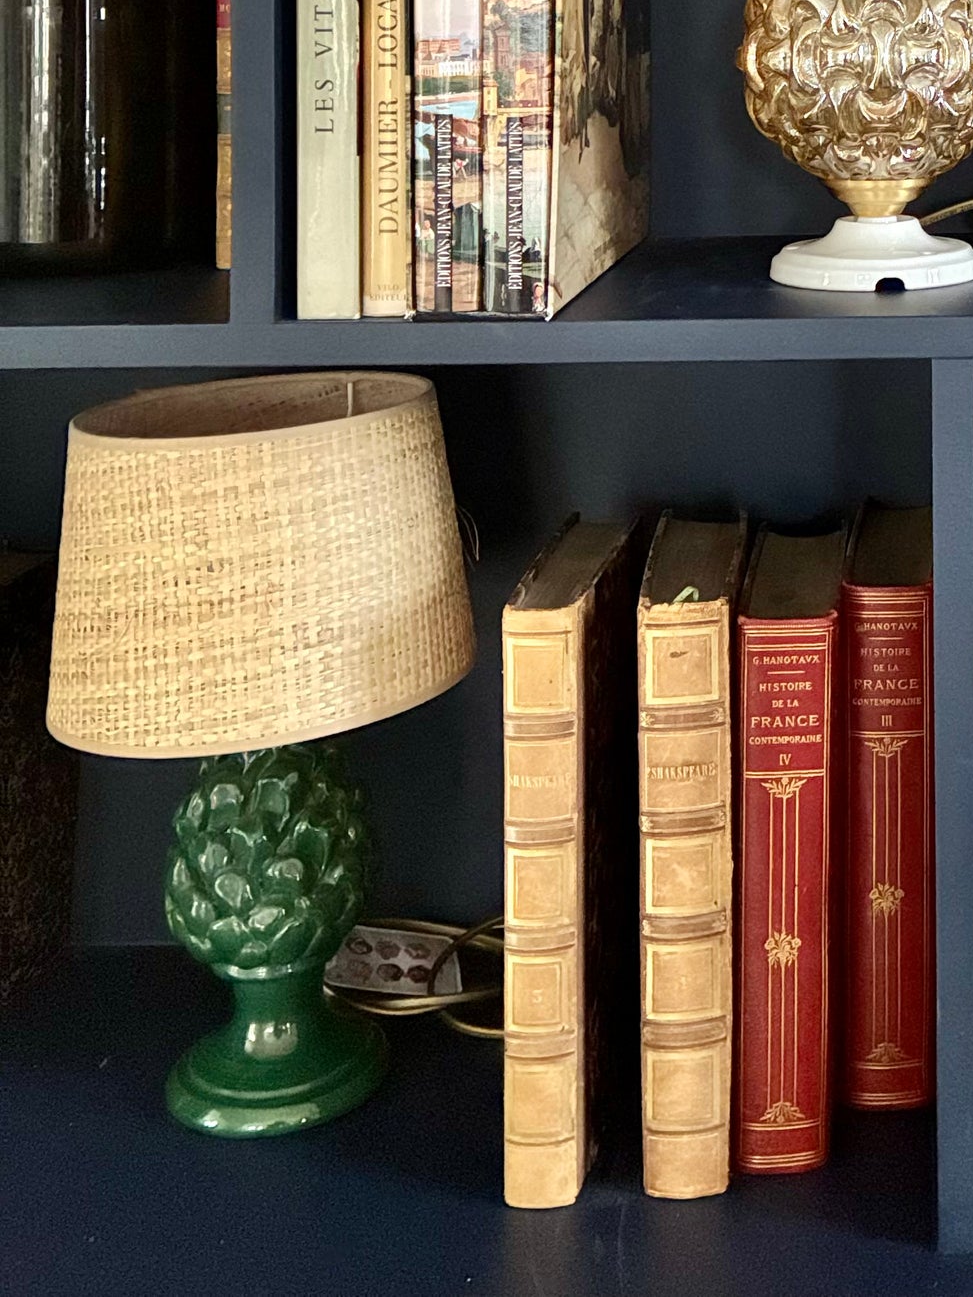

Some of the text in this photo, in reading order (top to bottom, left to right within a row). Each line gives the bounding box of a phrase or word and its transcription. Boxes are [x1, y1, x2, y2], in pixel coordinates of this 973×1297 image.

[314, 78, 334, 134] LES
[378, 97, 399, 235] DAUMIER
[437, 119, 451, 288] EDITIONS JEAN-CLAUDE LATTES
[508, 122, 523, 290] EDITIONS JEAN-CLAUDE LATTES
[860, 648, 911, 657] HISTOIRE
[873, 664, 899, 672] DE LA
[759, 681, 812, 692] HISTOIRE
[854, 679, 919, 690] FRANCE
[772, 699, 799, 708] DE LA
[852, 697, 922, 707] CONTEMPORAINE
[751, 715, 820, 728] FRANCE
[881, 715, 892, 727] III
[749, 734, 822, 745] CONTEMPORAINE
[779, 754, 792, 765] IV
